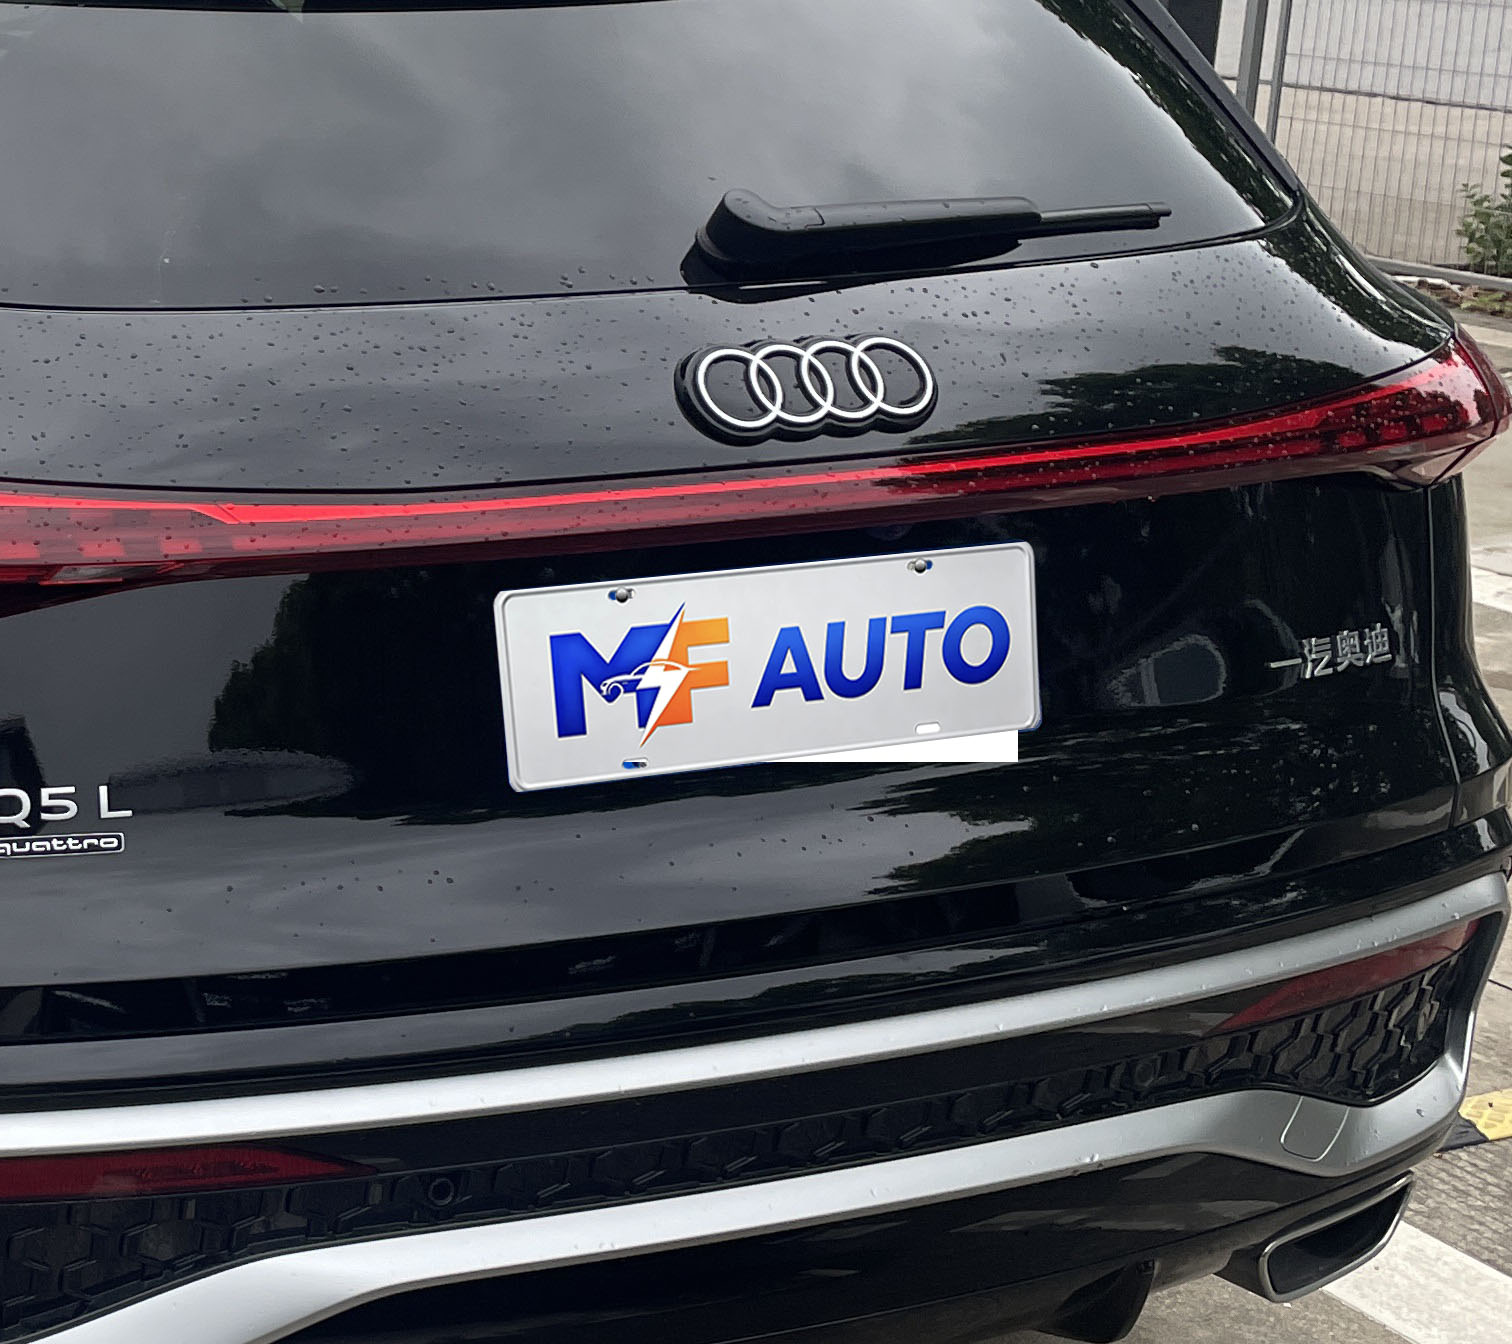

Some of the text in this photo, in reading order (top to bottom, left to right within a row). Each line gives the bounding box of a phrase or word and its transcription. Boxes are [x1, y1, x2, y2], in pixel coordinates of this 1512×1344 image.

[1269, 622, 1393, 679] 一汽奥迪
[97, 784, 134, 819] L
